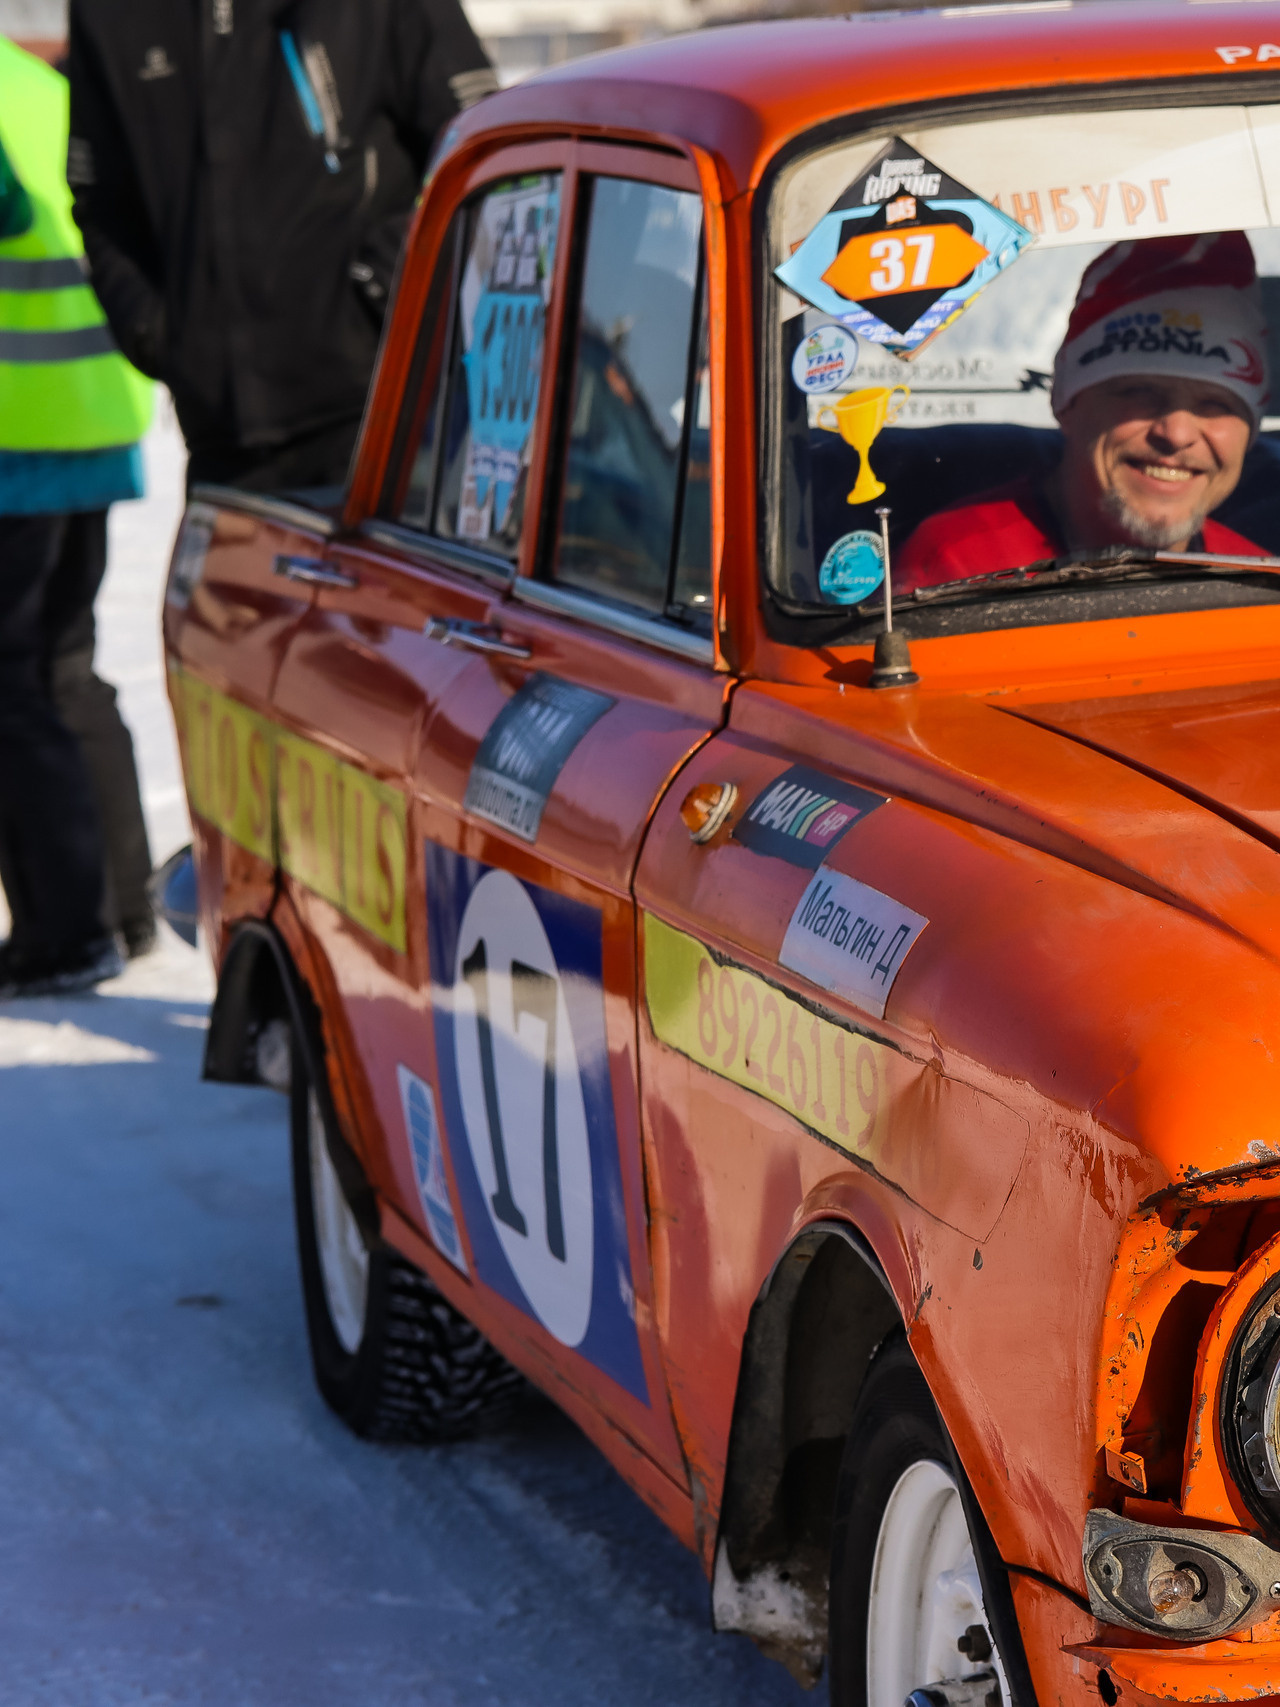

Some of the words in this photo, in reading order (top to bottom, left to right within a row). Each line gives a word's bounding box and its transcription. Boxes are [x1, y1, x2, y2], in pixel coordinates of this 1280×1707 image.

[989, 178, 1170, 235] НБУРГ
[869, 234, 935, 292] 37
[805, 369, 843, 385] ФЕСТ
[807, 352, 844, 367] УРАЛ
[749, 780, 822, 834] MAX
[814, 811, 849, 837] HP
[797, 879, 885, 964] Мальгин
[871, 924, 911, 986] Д
[461, 936, 567, 1265] 17
